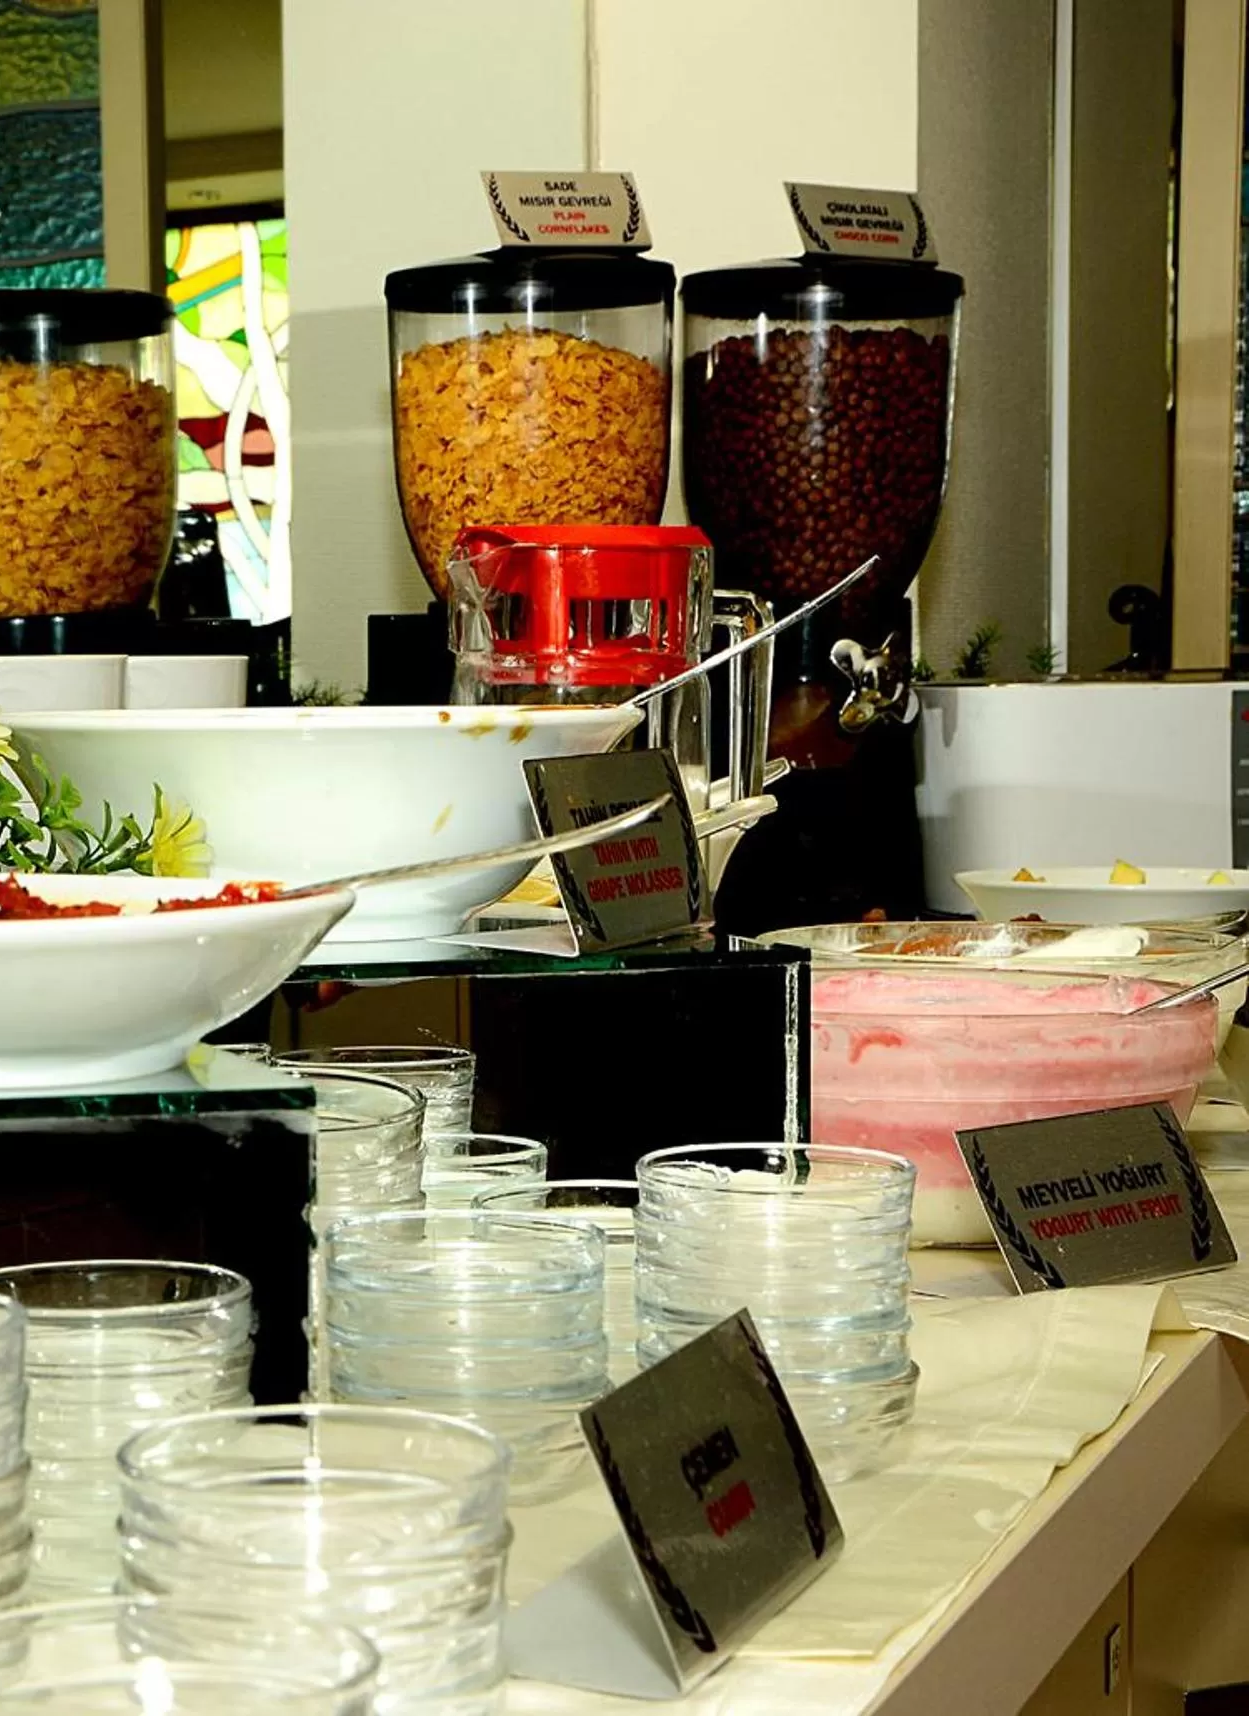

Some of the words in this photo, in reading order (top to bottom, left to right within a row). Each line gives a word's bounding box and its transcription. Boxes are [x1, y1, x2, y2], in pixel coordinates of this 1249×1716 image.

[544, 181, 578, 191] SADE
[519, 196, 555, 207] MISIR
[553, 211, 586, 220] PLAIN
[538, 224, 609, 234] CORNFLAKES
[587, 876, 626, 901] GRAPE
[625, 867, 683, 896] MOLASSES
[1016, 1168, 1097, 1210] MEYVELİ
[1095, 1163, 1167, 1193] YOĞURT
[1029, 1211, 1095, 1240] YOGURT
[1096, 1204, 1138, 1229] WITH
[1139, 1194, 1183, 1219] FRUIT
